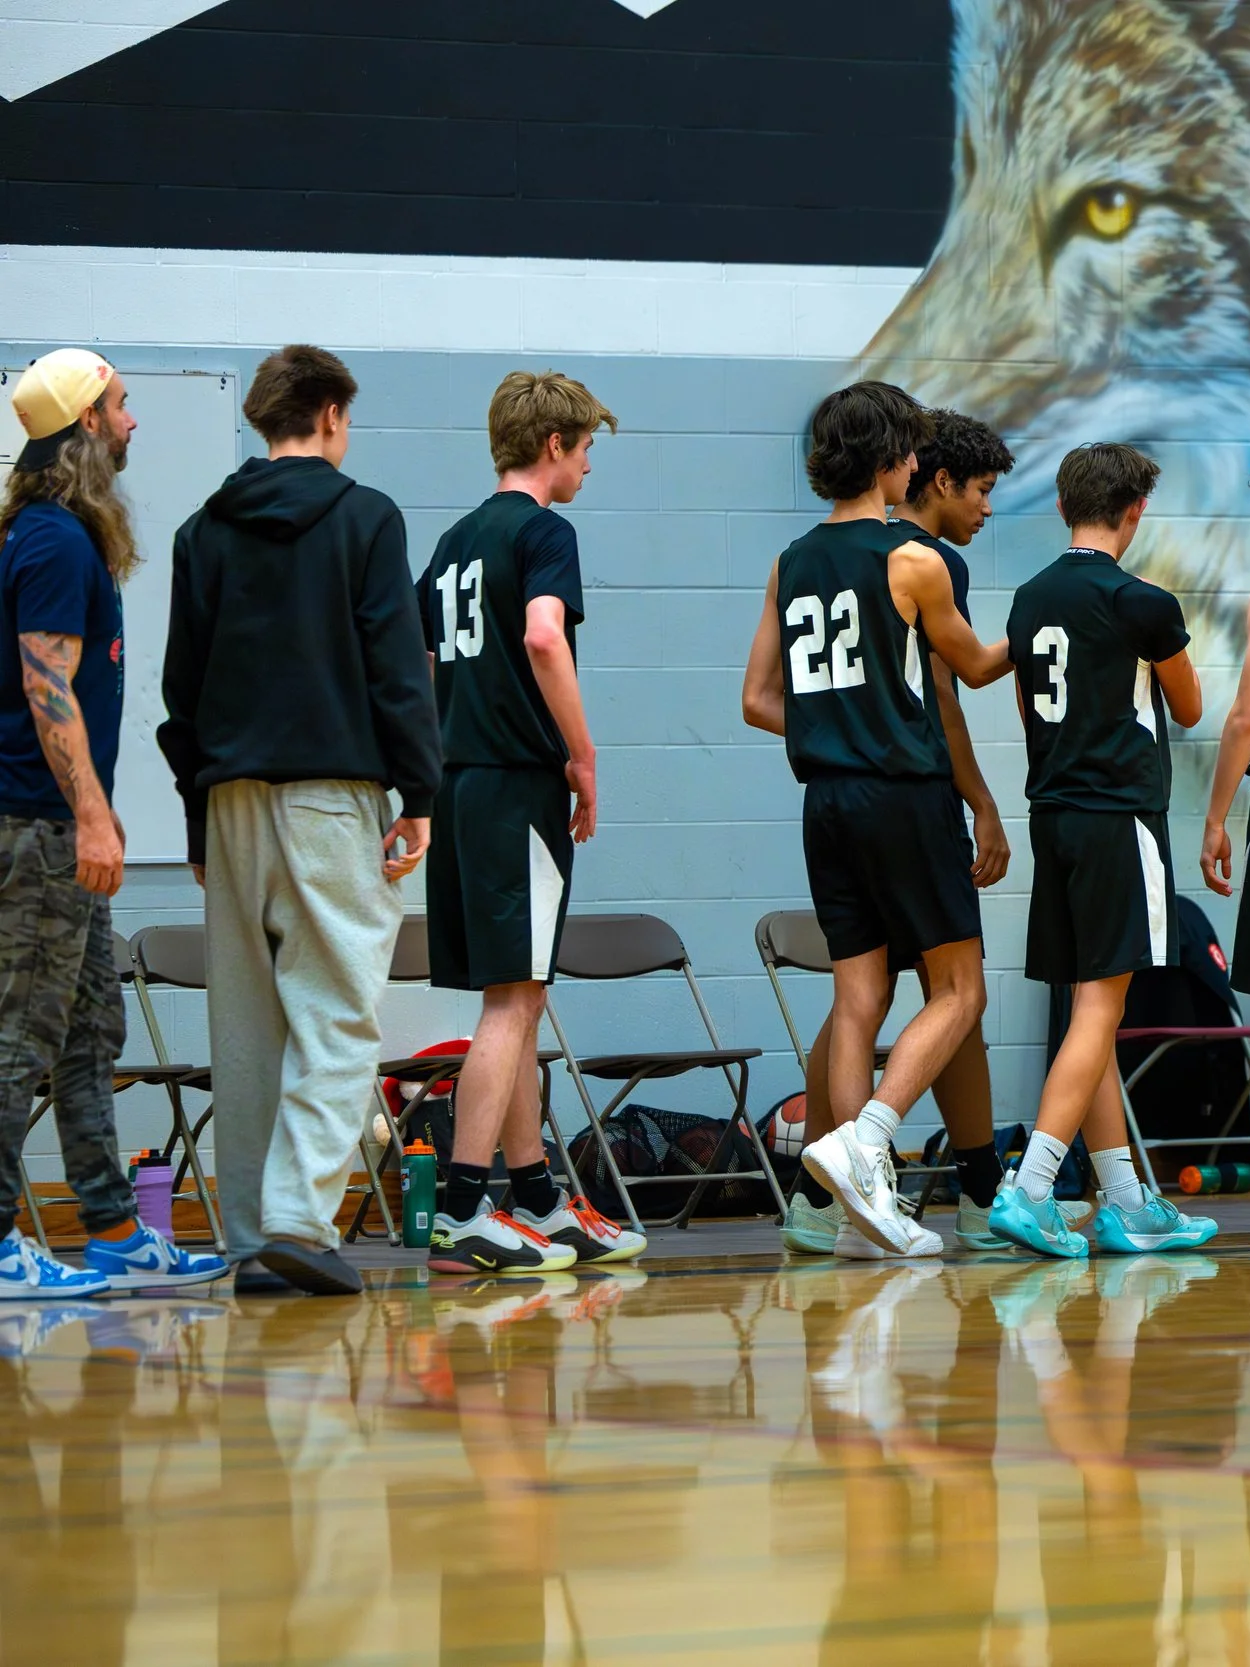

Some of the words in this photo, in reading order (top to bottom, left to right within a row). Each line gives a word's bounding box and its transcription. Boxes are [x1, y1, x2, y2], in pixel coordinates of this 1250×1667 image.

[436, 558, 484, 662] 13
[785, 588, 867, 695] 22
[1032, 626, 1070, 724] 3
